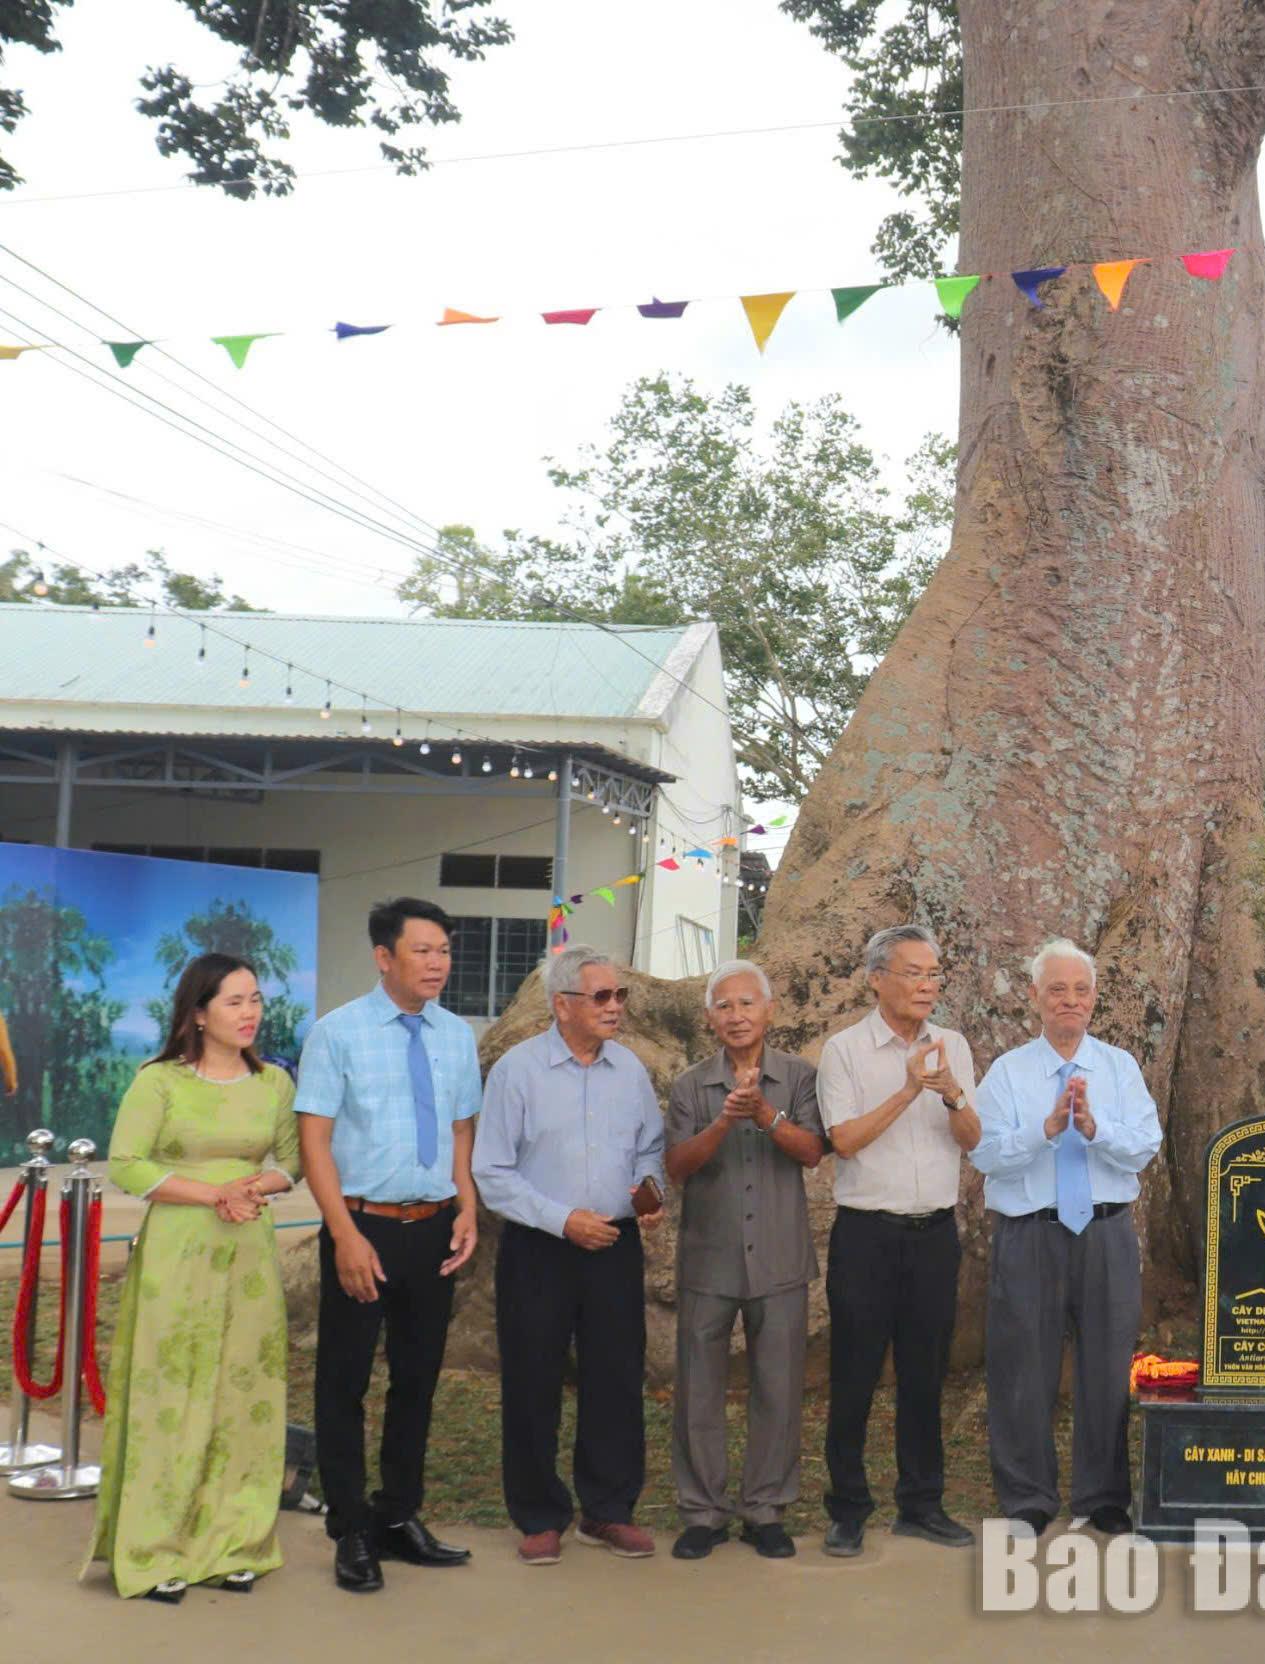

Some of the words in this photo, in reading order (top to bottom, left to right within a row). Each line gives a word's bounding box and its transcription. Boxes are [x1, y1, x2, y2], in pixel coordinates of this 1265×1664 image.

[1231, 1305, 1252, 1315] CÂY
[1255, 1307, 1265, 1315] DI
[1233, 1341, 1255, 1351] CÂY
[1184, 1446, 1205, 1461] CÂY
[1207, 1448, 1235, 1461] XANH
[1244, 1448, 1255, 1462] DI
[1226, 1469, 1245, 1485] HÃY
